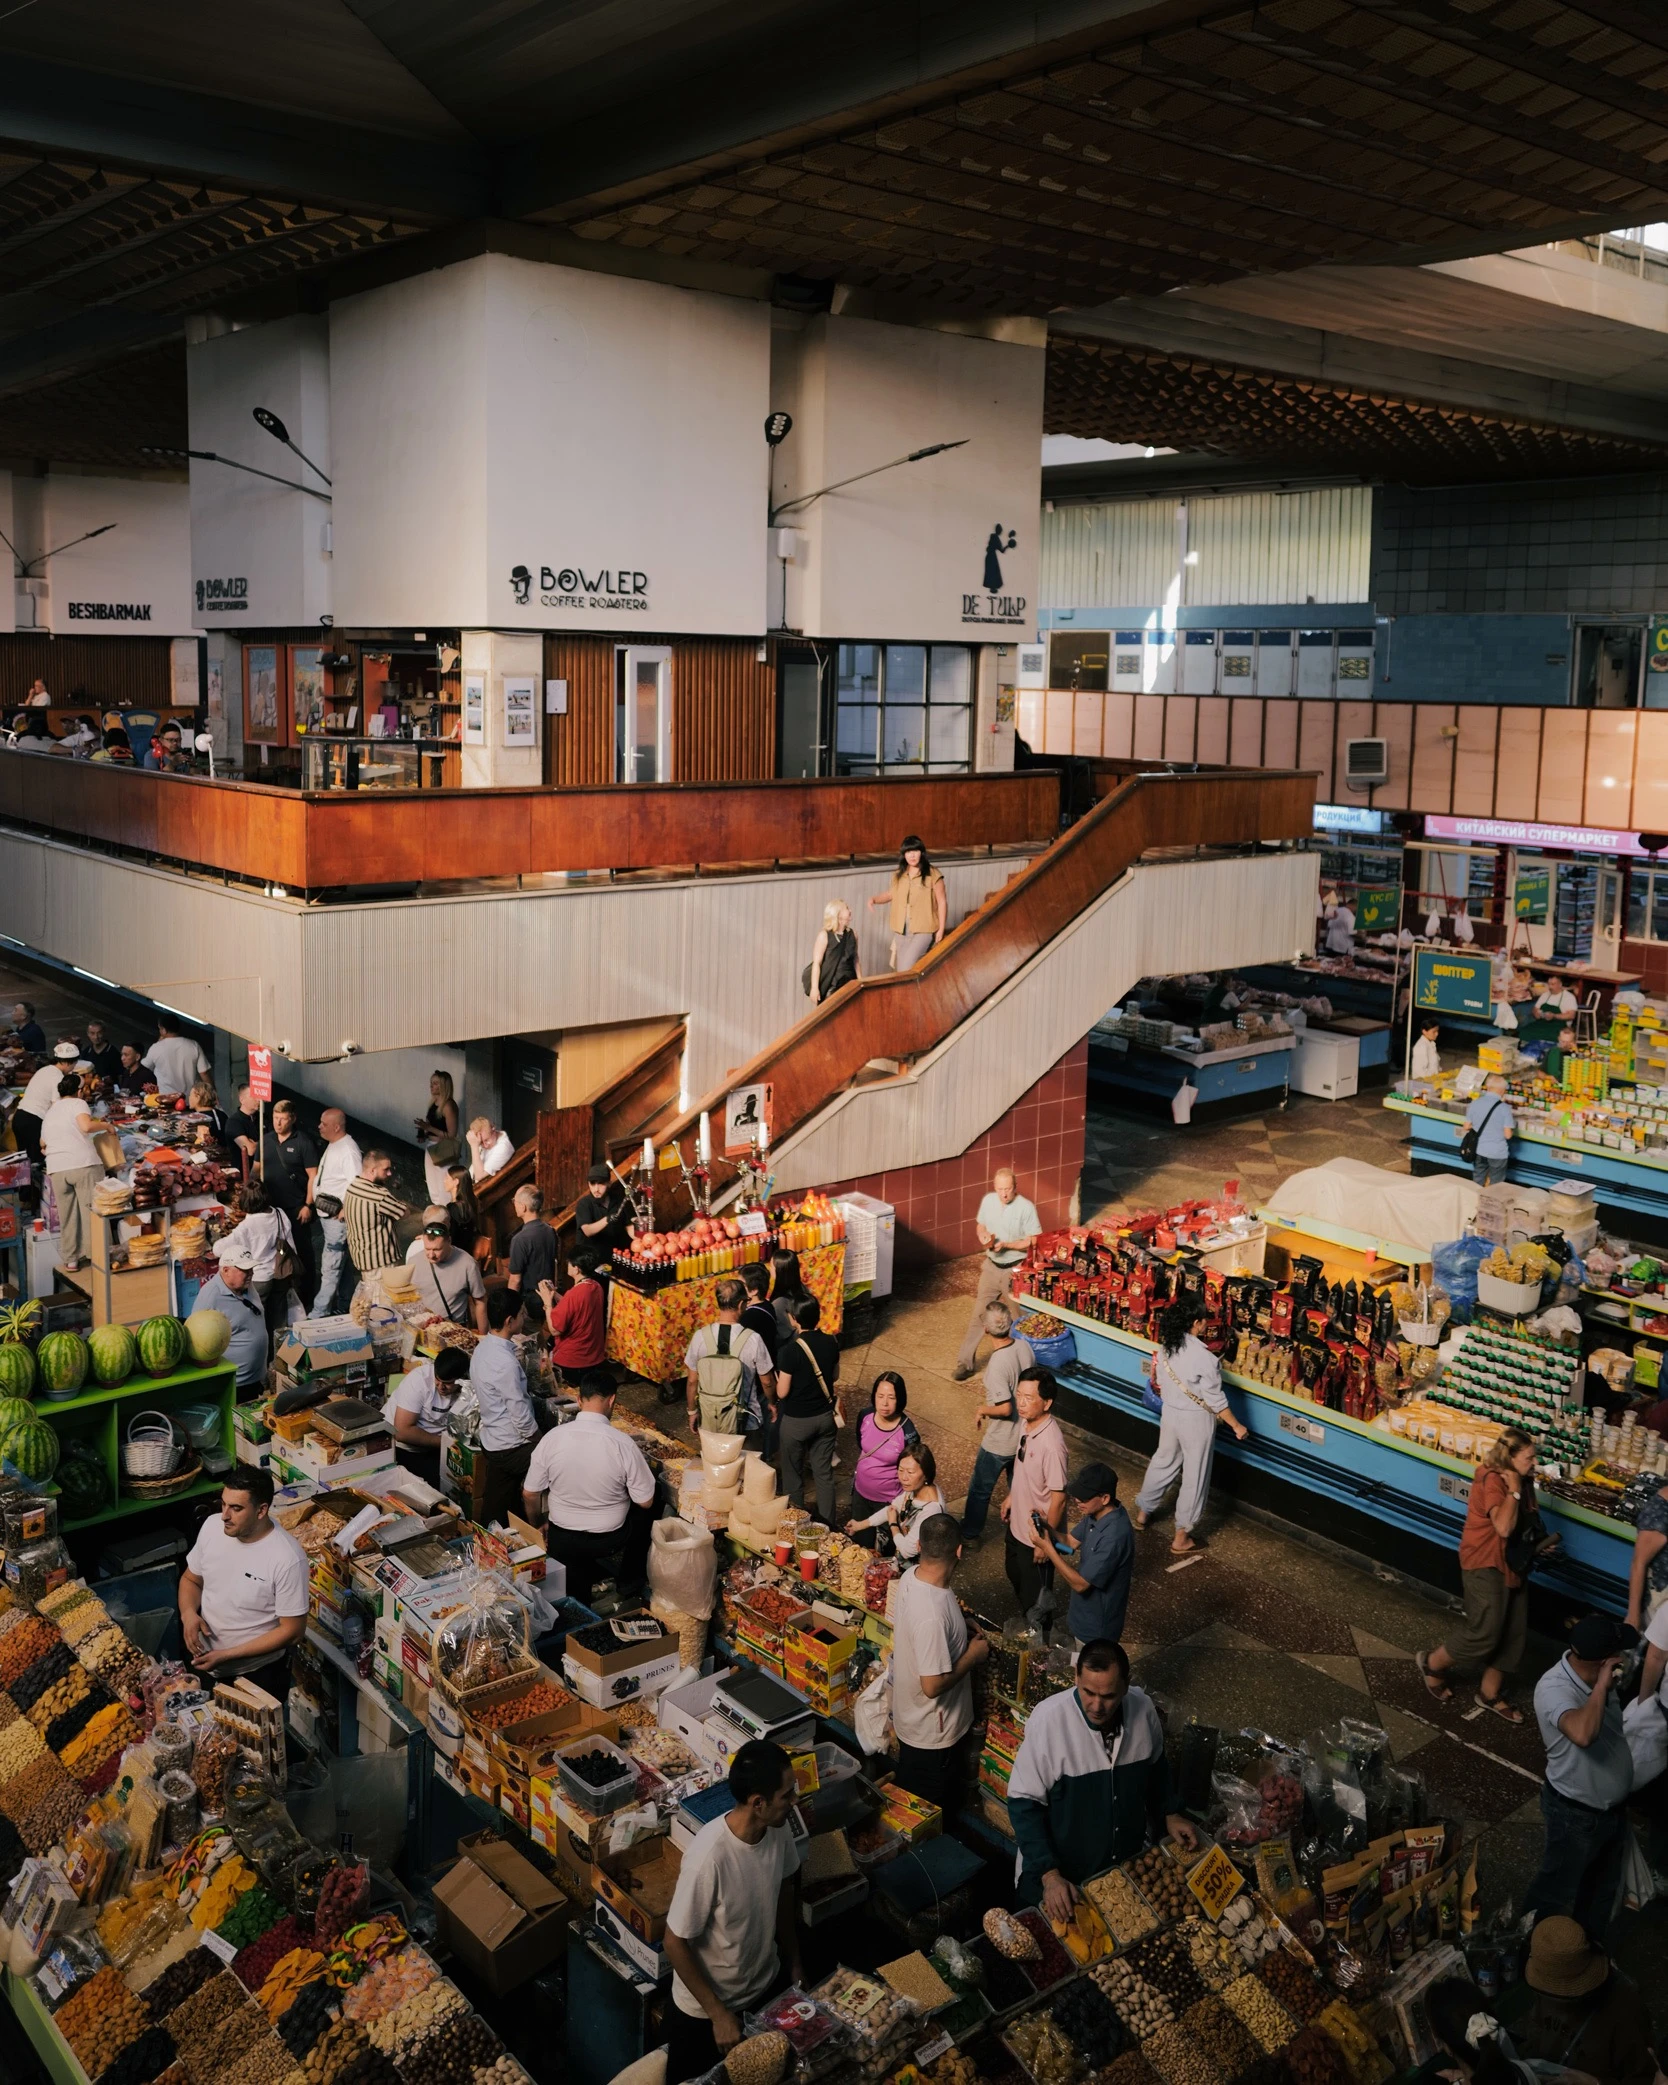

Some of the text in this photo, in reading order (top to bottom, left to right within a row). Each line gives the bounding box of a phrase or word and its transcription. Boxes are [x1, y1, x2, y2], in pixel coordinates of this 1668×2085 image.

[206, 577, 248, 599] BOWLER
[541, 566, 648, 596] BOWLER
[68, 602, 151, 621] BESHBARMAK
[541, 595, 648, 611] COFFEE ROASTERS
[962, 594, 980, 615] DE
[1316, 810, 1362, 822] РОДУКЦИЯ
[1455, 820, 1620, 847] КИТАЙСКИЙ СУПЕРМАРКЕТ
[1295, 1424, 1307, 1434] 40
[448, 1458, 464, 1477] NUTS
[1459, 1488, 1469, 1498] 41
[645, 1662, 676, 1681] PRUNES
[1194, 1853, 1218, 1887] DISCOUNT
[1203, 1860, 1232, 1900] 50%
[1215, 1881, 1236, 1909] СКИДКА
[637, 1945, 657, 1970] Prunes
